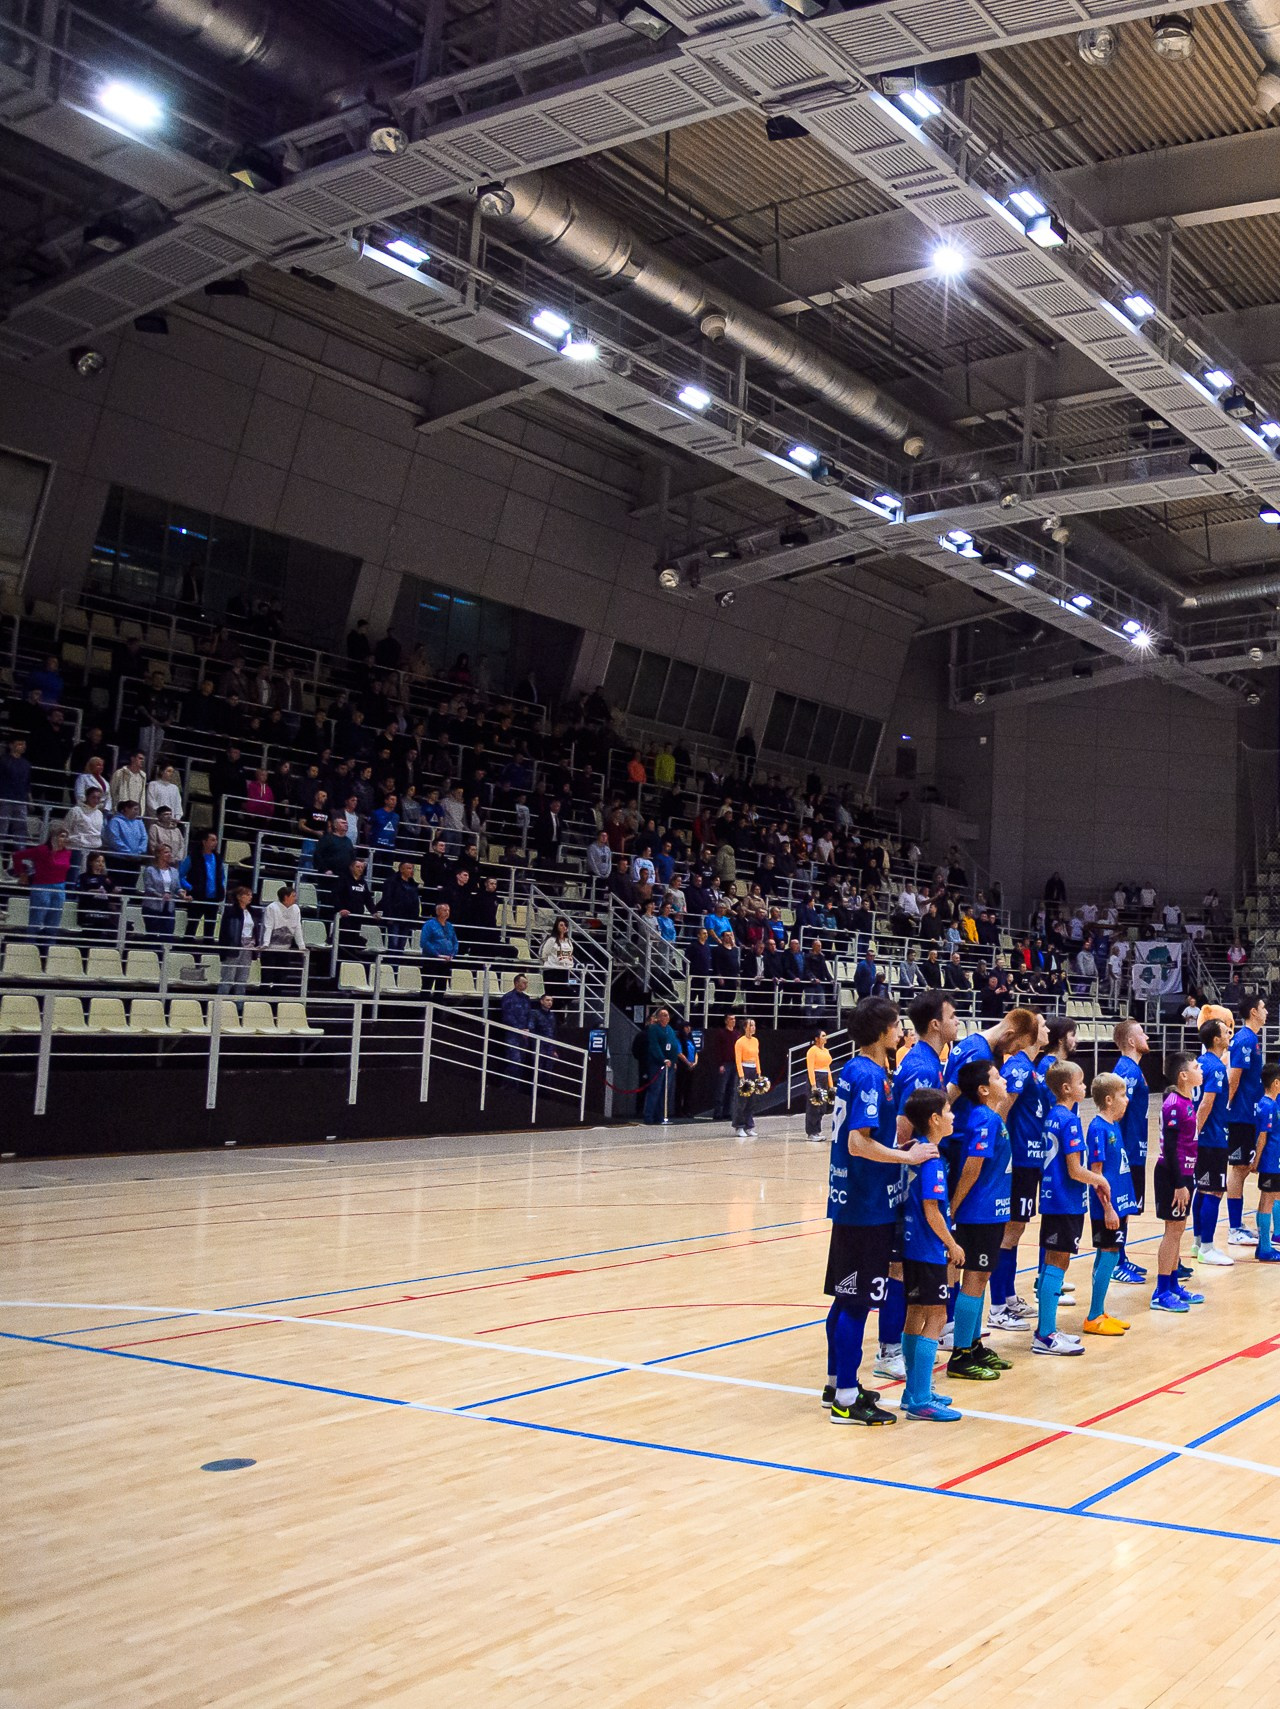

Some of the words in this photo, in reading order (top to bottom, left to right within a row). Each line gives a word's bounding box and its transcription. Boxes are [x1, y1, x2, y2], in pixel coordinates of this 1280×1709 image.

[593, 1037, 603, 1048] 2
[1020, 1198, 1033, 1216] 19
[979, 1254, 989, 1266] 8
